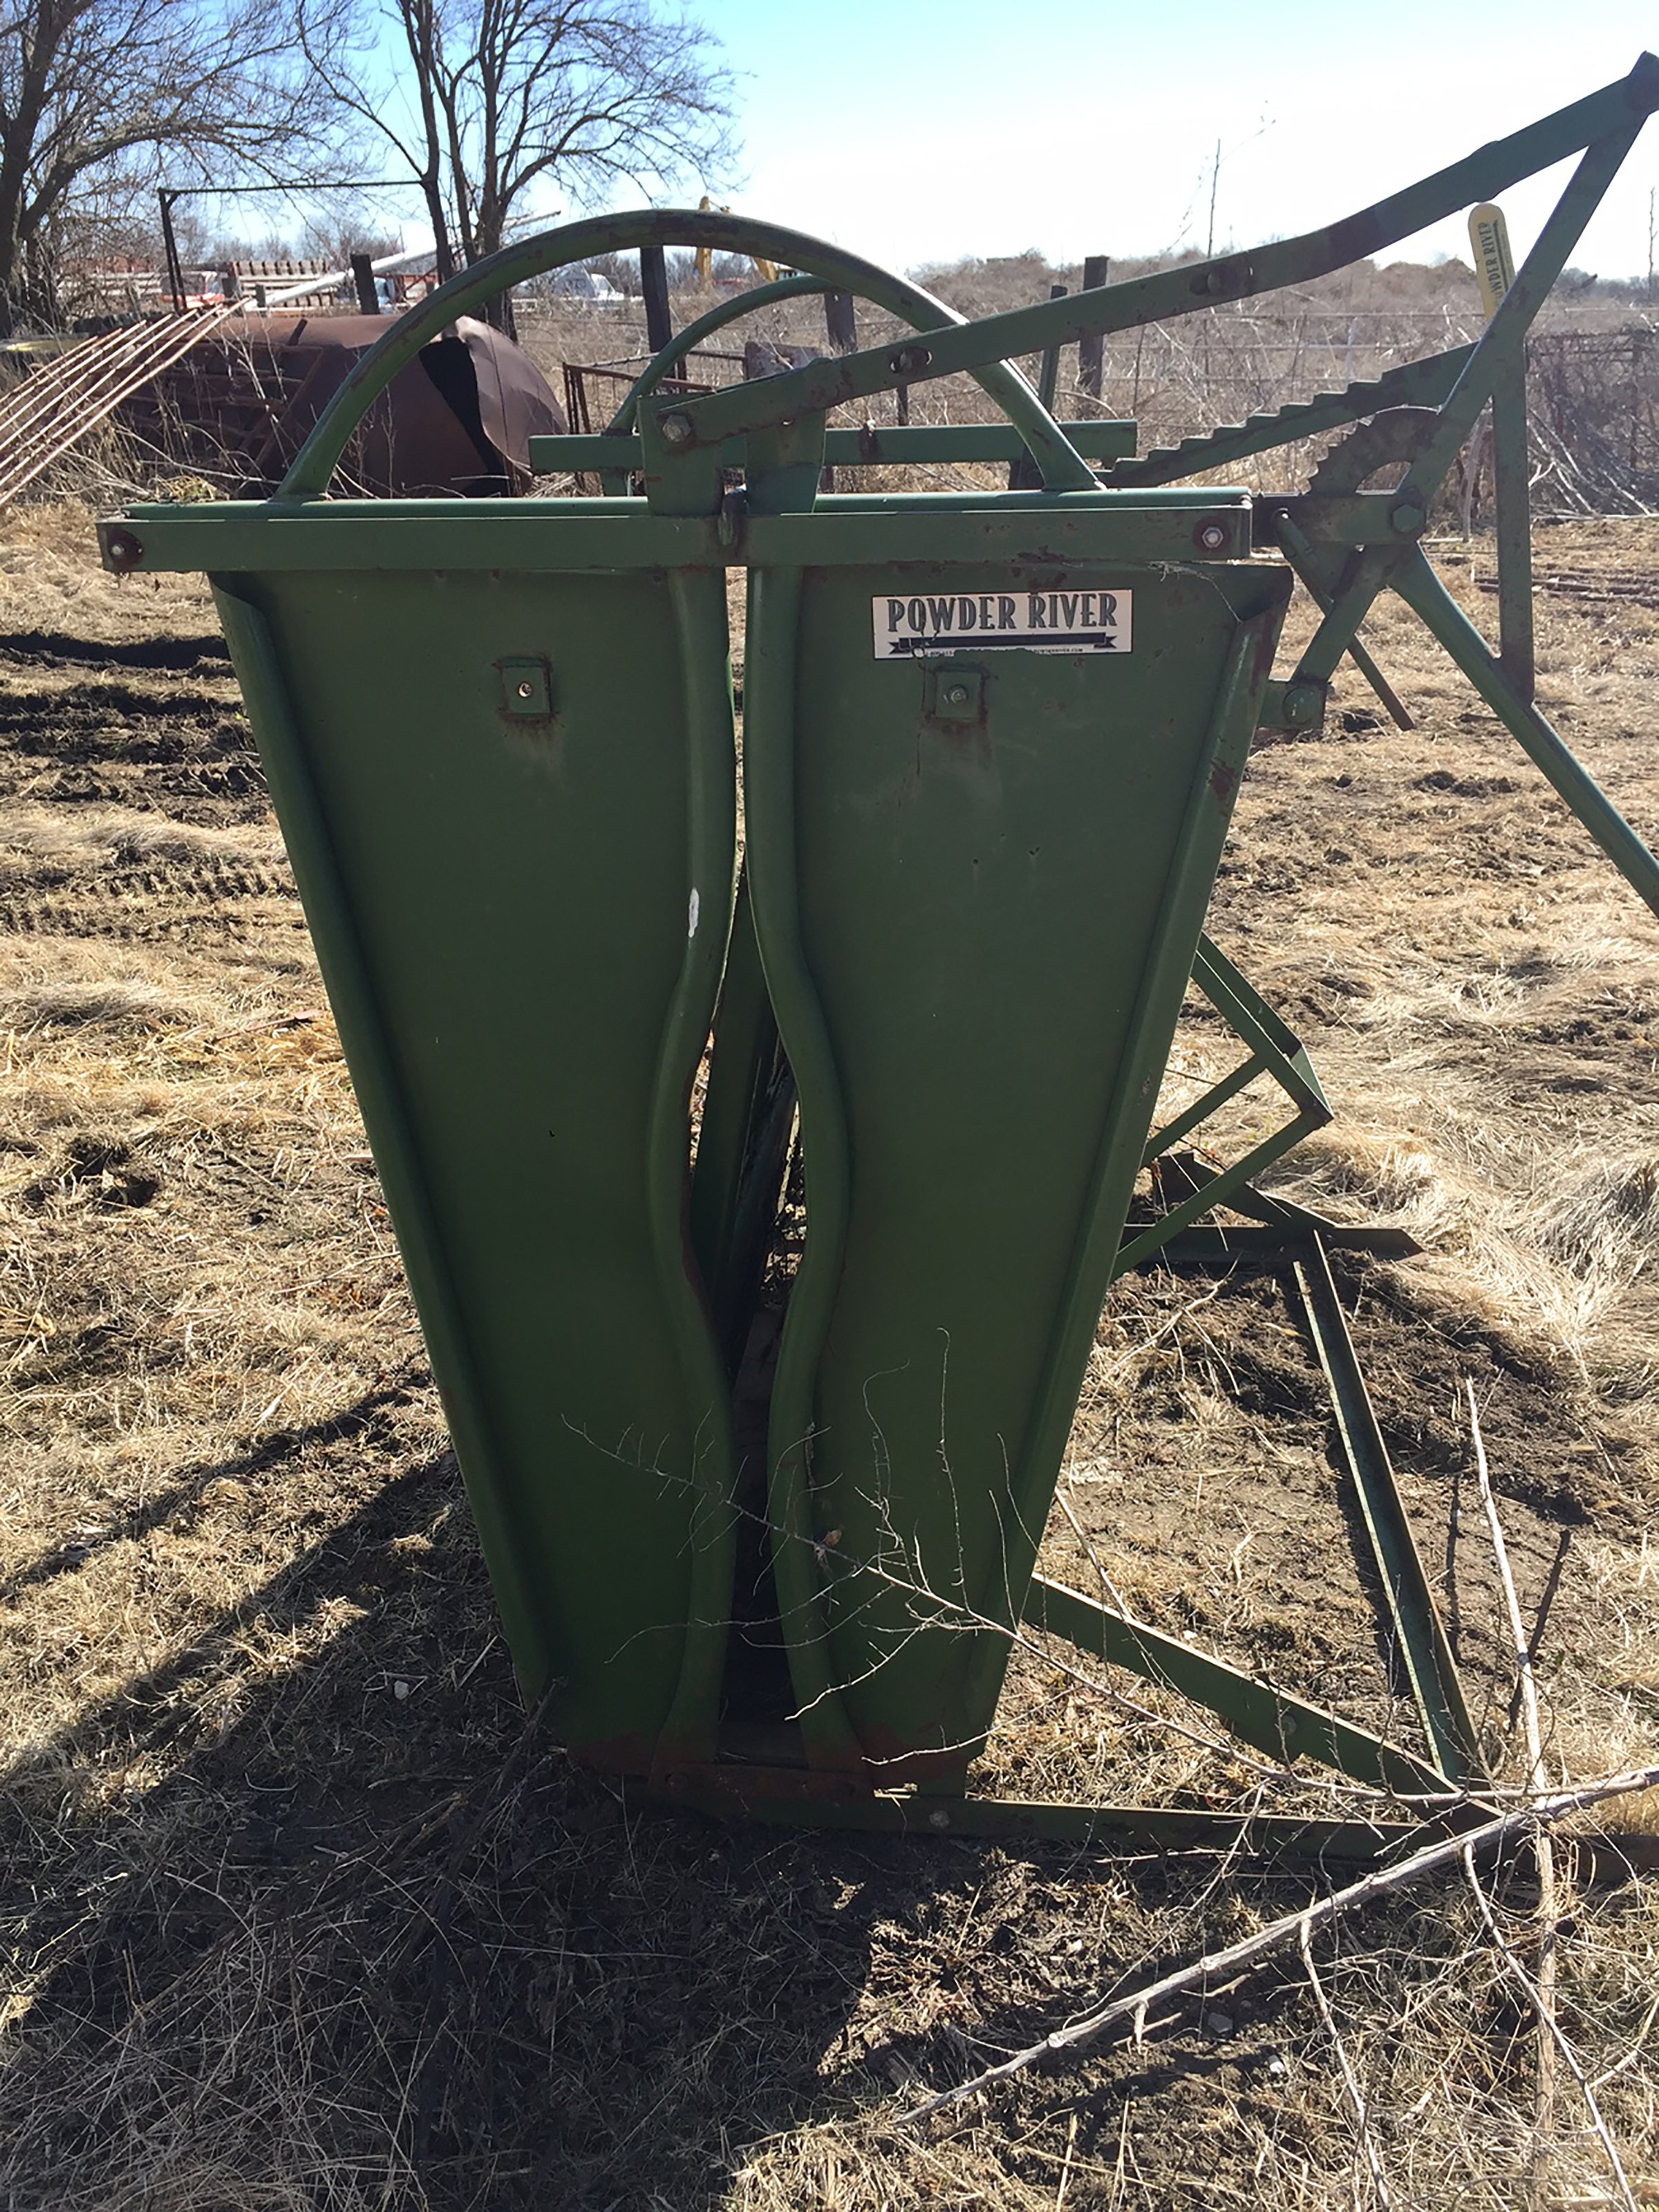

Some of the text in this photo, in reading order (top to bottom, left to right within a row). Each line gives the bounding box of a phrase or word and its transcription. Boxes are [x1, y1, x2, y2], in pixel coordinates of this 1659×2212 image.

[1478, 221, 1503, 306] OWDER RIVER
[887, 592, 1118, 632] POWDER RIVER
